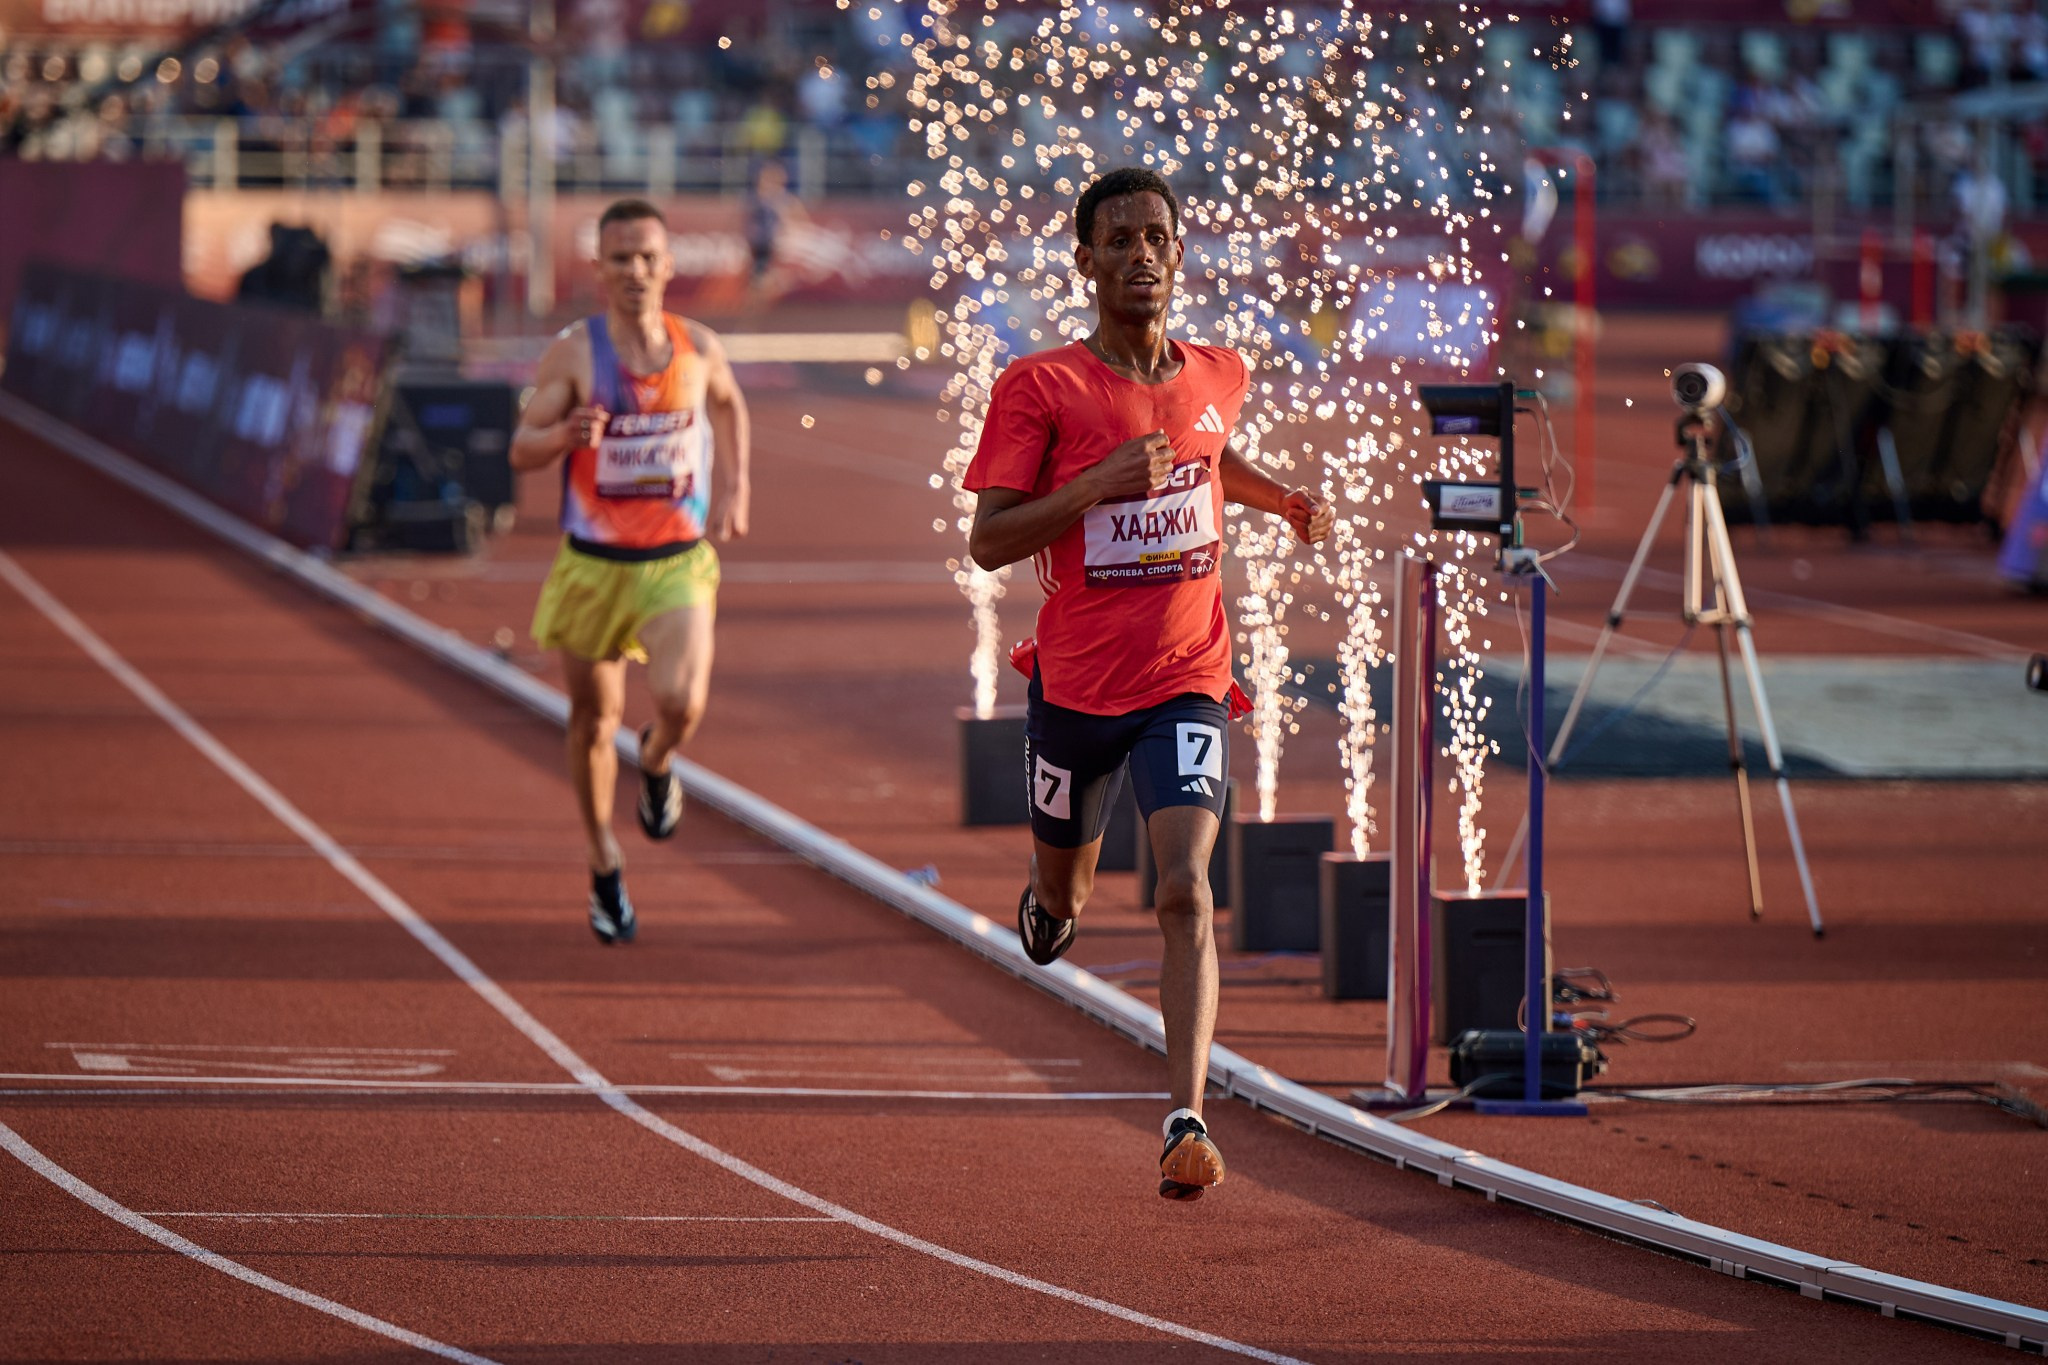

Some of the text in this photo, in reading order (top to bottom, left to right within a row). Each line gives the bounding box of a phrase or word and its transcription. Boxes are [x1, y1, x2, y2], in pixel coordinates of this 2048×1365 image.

[1111, 506, 1198, 545] ХАДЖИ
[1092, 568, 1144, 578] КОРОЛЕВА
[1147, 563, 1184, 576] СПОРТА
[1145, 552, 1175, 562] ФИНАЛ
[1187, 732, 1213, 766] 7
[1041, 768, 1062, 807] 7
